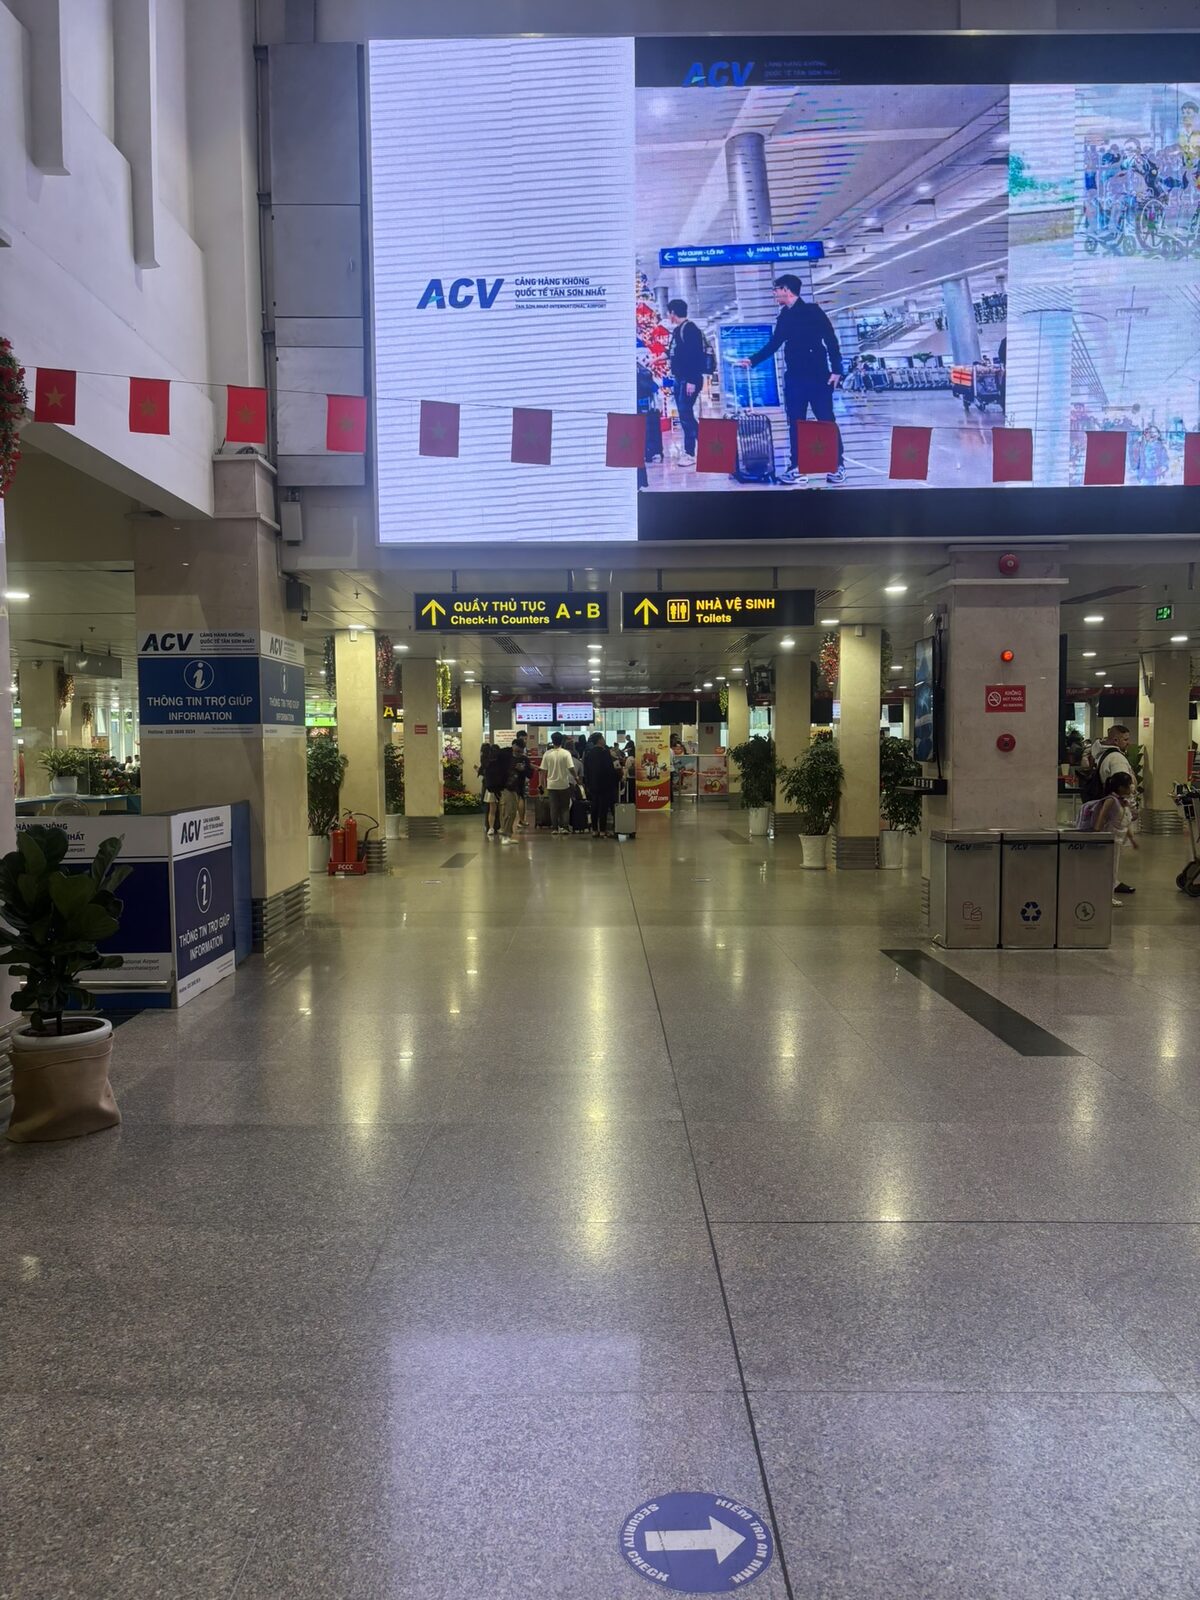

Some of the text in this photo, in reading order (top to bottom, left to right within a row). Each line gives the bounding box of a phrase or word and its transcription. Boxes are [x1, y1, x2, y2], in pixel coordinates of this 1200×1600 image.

[682, 61, 755, 87] ACV
[514, 276, 590, 286] CẢNG HÀNG KHÔNG
[416, 278, 505, 309] ACV
[514, 286, 607, 298] QUỐC TẾ TÂN SƠN NHẤT
[491, 598, 518, 612] THỦ
[520, 601, 546, 613] TỤC
[555, 603, 571, 619] A
[587, 603, 600, 619] B
[696, 596, 776, 612] NHÀ VỆ SINH
[451, 614, 550, 625] Check-in Counters
[696, 614, 732, 623] Toilets
[141, 633, 194, 651] ACV
[147, 694, 253, 708] THÔNG TIN TRỢ GIÚP
[168, 711, 232, 721] INFORMATION
[383, 706, 395, 718] A
[181, 819, 201, 844] ACV
[179, 928, 198, 948] THÔNG
[199, 923, 208, 939] TIN
[208, 918, 218, 933] TRỢ
[189, 934, 224, 961] INFORMATION
[750, 1520, 767, 1540] TRA
[623, 1503, 670, 1582] SECURITY CHECK
[755, 1543, 768, 1558] AN
[731, 1559, 763, 1583] NINH
